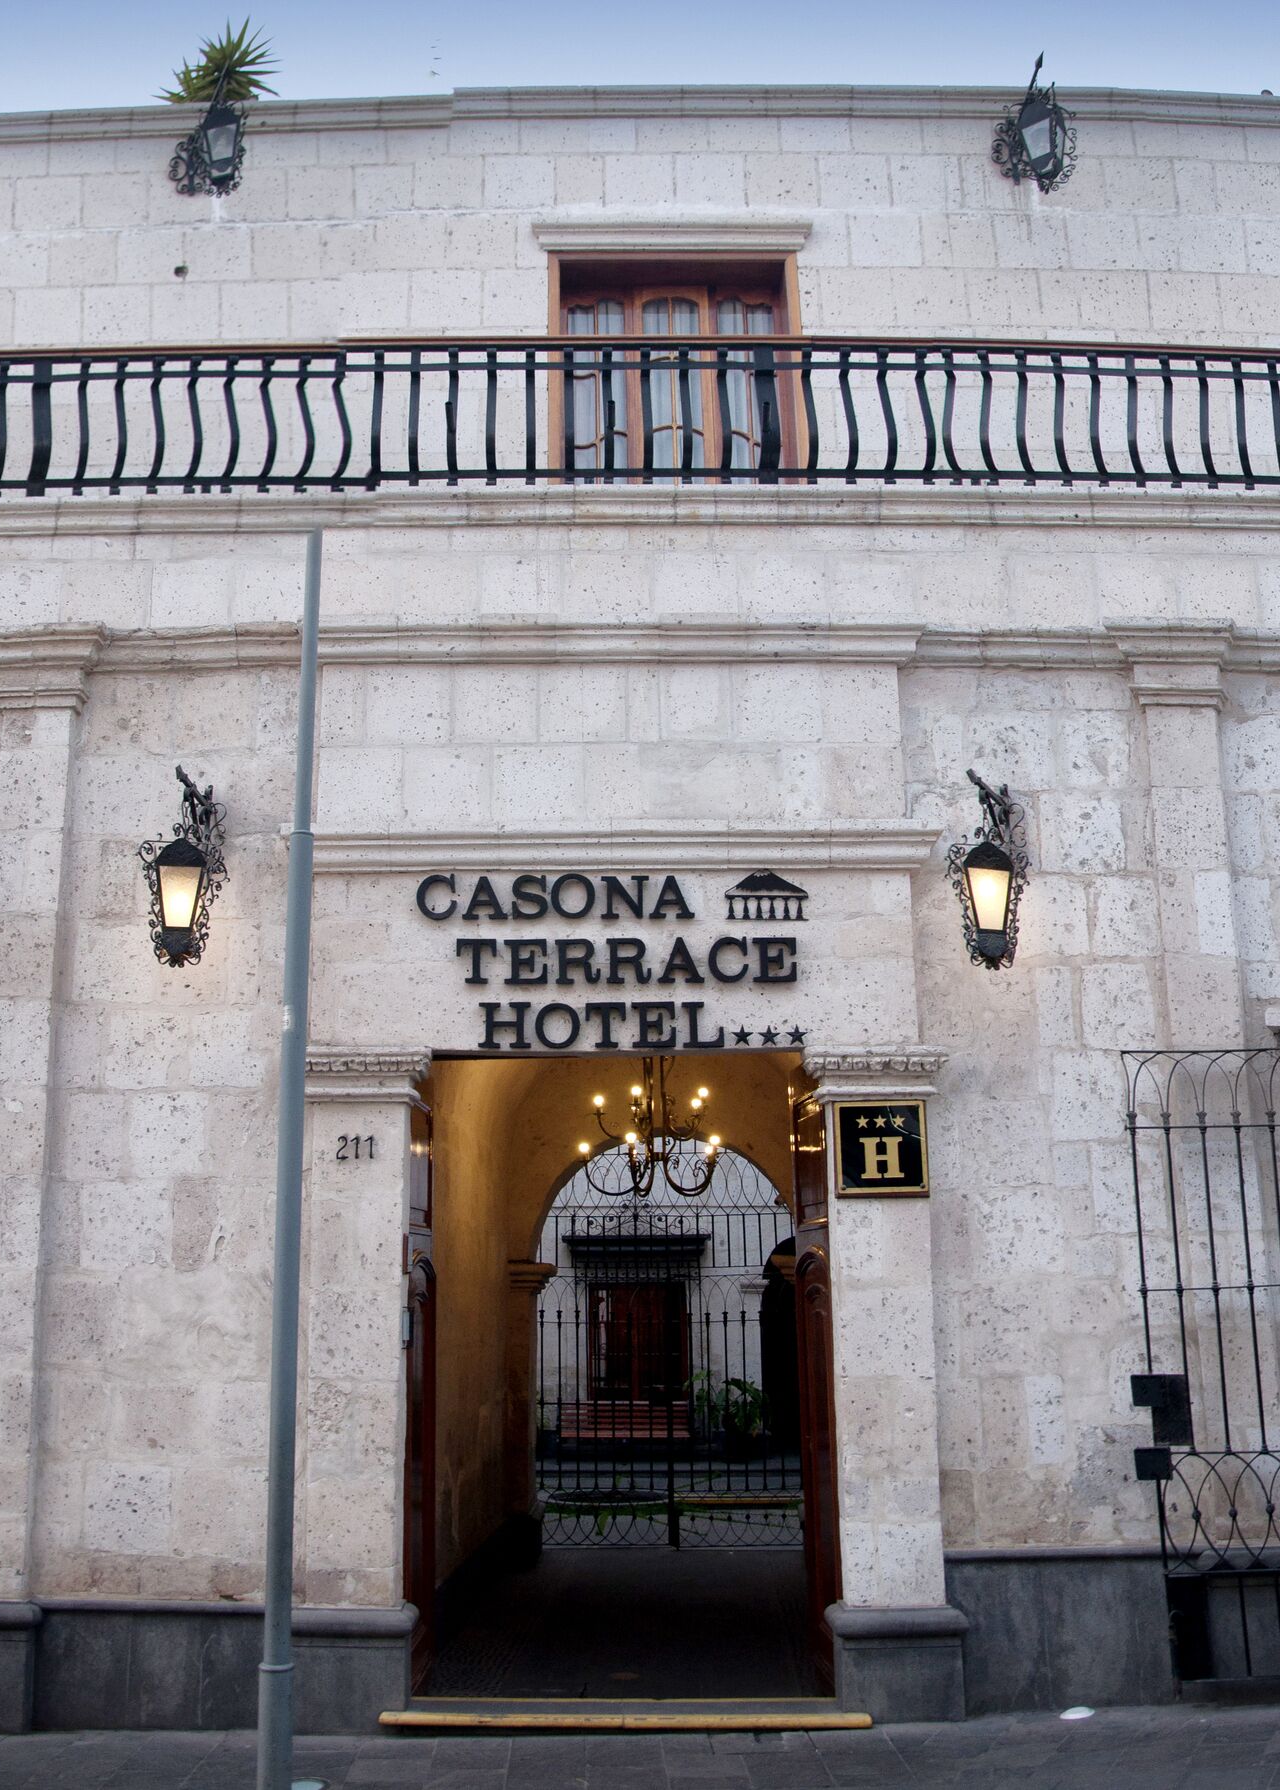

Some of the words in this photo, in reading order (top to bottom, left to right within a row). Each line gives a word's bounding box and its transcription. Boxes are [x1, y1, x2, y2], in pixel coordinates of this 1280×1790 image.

[416, 873, 695, 920] CASONA
[456, 936, 797, 985] TERRACE
[478, 1001, 725, 1049] HOTEL
[336, 1134, 374, 1160] 211
[859, 1136, 905, 1179] H
